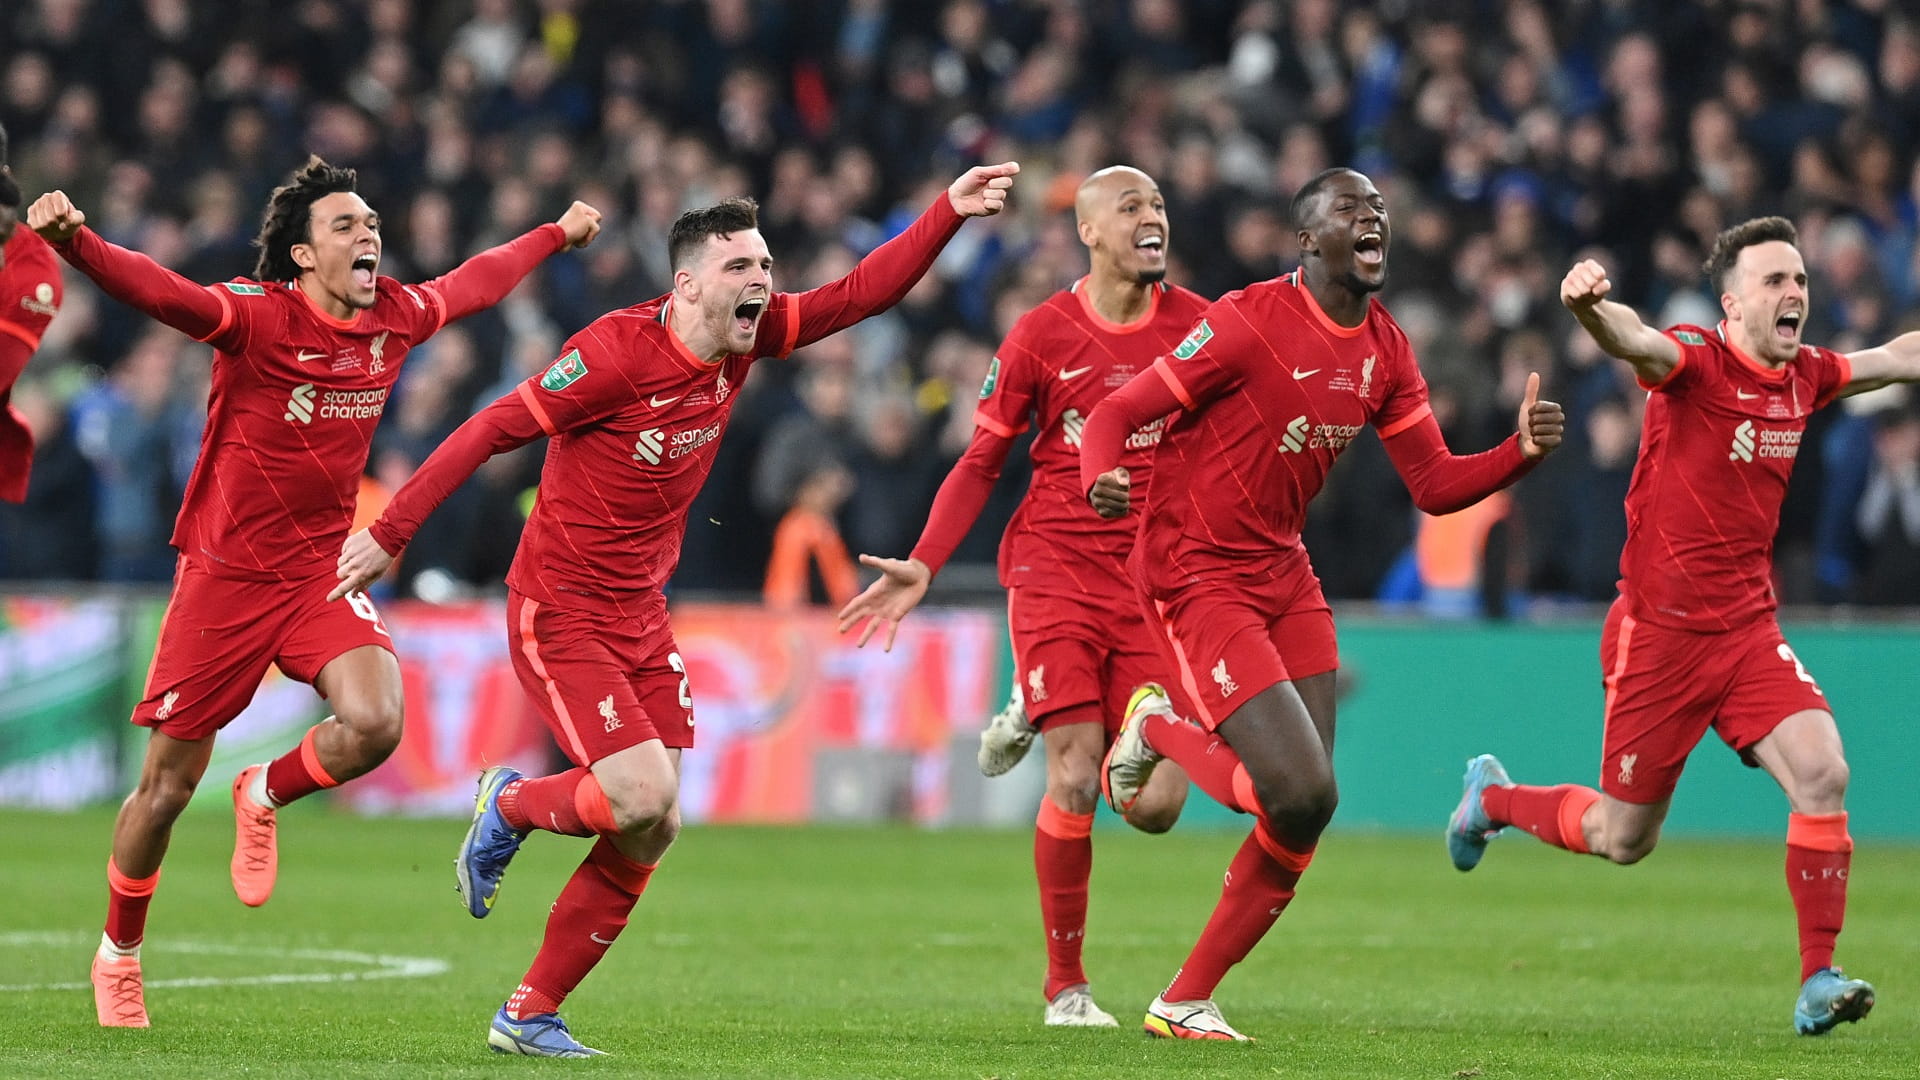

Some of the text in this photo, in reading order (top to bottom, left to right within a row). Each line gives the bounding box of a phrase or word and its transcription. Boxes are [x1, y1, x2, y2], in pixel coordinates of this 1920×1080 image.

[369, 361, 387, 376] LFC
[322, 387, 387, 404] standard
[1359, 388, 1370, 398] LFC
[1313, 423, 1363, 438] standar
[1760, 428, 1803, 444] standar
[1221, 681, 1240, 698] LFC
[604, 719, 625, 733] LFC
